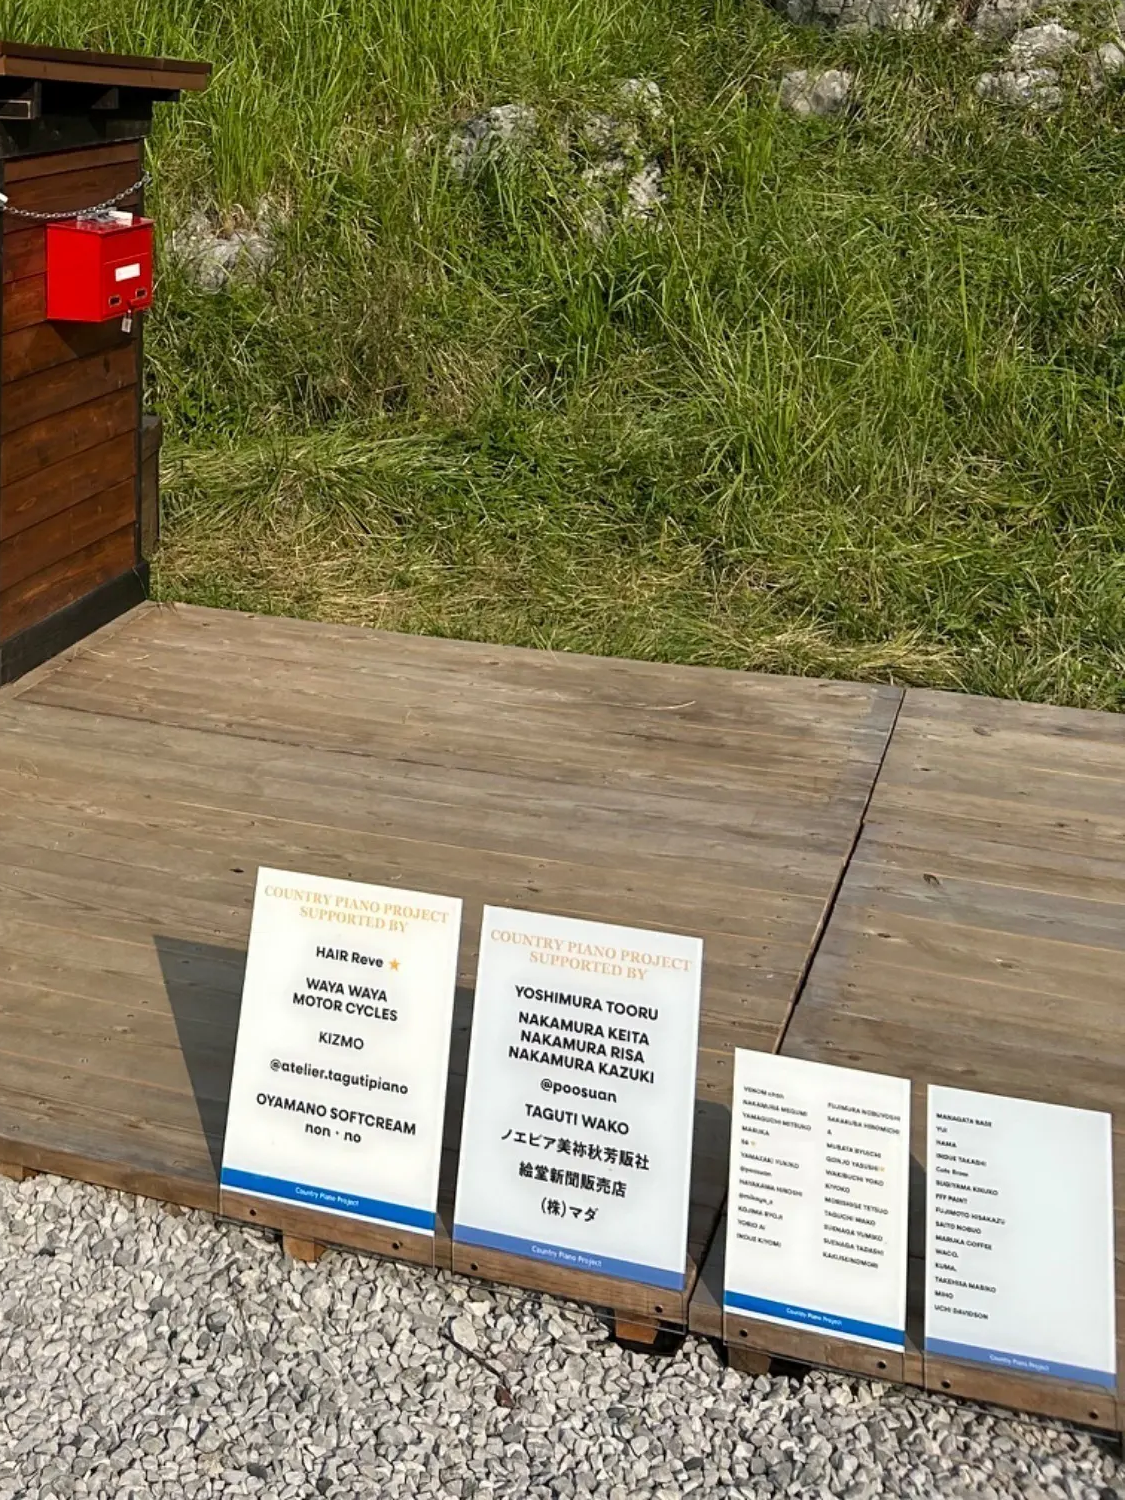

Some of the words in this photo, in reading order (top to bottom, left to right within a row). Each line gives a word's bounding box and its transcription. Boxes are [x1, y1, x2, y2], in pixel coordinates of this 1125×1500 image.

[264, 884, 332, 905] COUNTRY
[336, 896, 380, 913] PIANO
[384, 903, 449, 924] PROJECT
[300, 905, 385, 930] SUPPORTED
[389, 920, 407, 934] BY
[315, 946, 348, 962] HAIR
[352, 952, 383, 968] Reve
[490, 929, 563, 951] COUNTRY
[567, 941, 617, 960] PIANO
[621, 949, 691, 972] PROJECT
[530, 951, 622, 977] SUPPORTED
[627, 967, 646, 981] BY
[306, 978, 344, 994] WAYA
[348, 985, 387, 1002] WAYA
[515, 985, 602, 1011] YOSHIMURA
[606, 1001, 658, 1021] TOORU
[293, 993, 342, 1012] MOTOR
[346, 1002, 398, 1022] CYCLES
[318, 1032, 364, 1050] KIZMO
[518, 1011, 604, 1037] NAKAMURA
[608, 1027, 649, 1045] KEITA
[520, 1029, 607, 1056] NAKAMURA
[610, 1046, 645, 1063] RISA
[270, 1058, 409, 1094] @atelier.tagutipiano
[508, 1046, 594, 1072] NAKAMURA
[599, 1062, 654, 1083] KAZUKI
[540, 1079, 617, 1102] @poosuan
[256, 1093, 327, 1118] OYAMANO
[330, 1107, 416, 1136] SOFTCREAM
[524, 1104, 577, 1125] TAGUTI
[582, 1115, 629, 1135] WAKO
[519, 1161, 627, 1198] 絵堂新聞販売店
[295, 1186, 319, 1198] Country
[320, 1192, 335, 1201] Piano
[337, 1195, 359, 1208] Project
[532, 1245, 557, 1258] Country
[558, 1251, 576, 1262] Piano
[578, 1255, 602, 1268] Project
